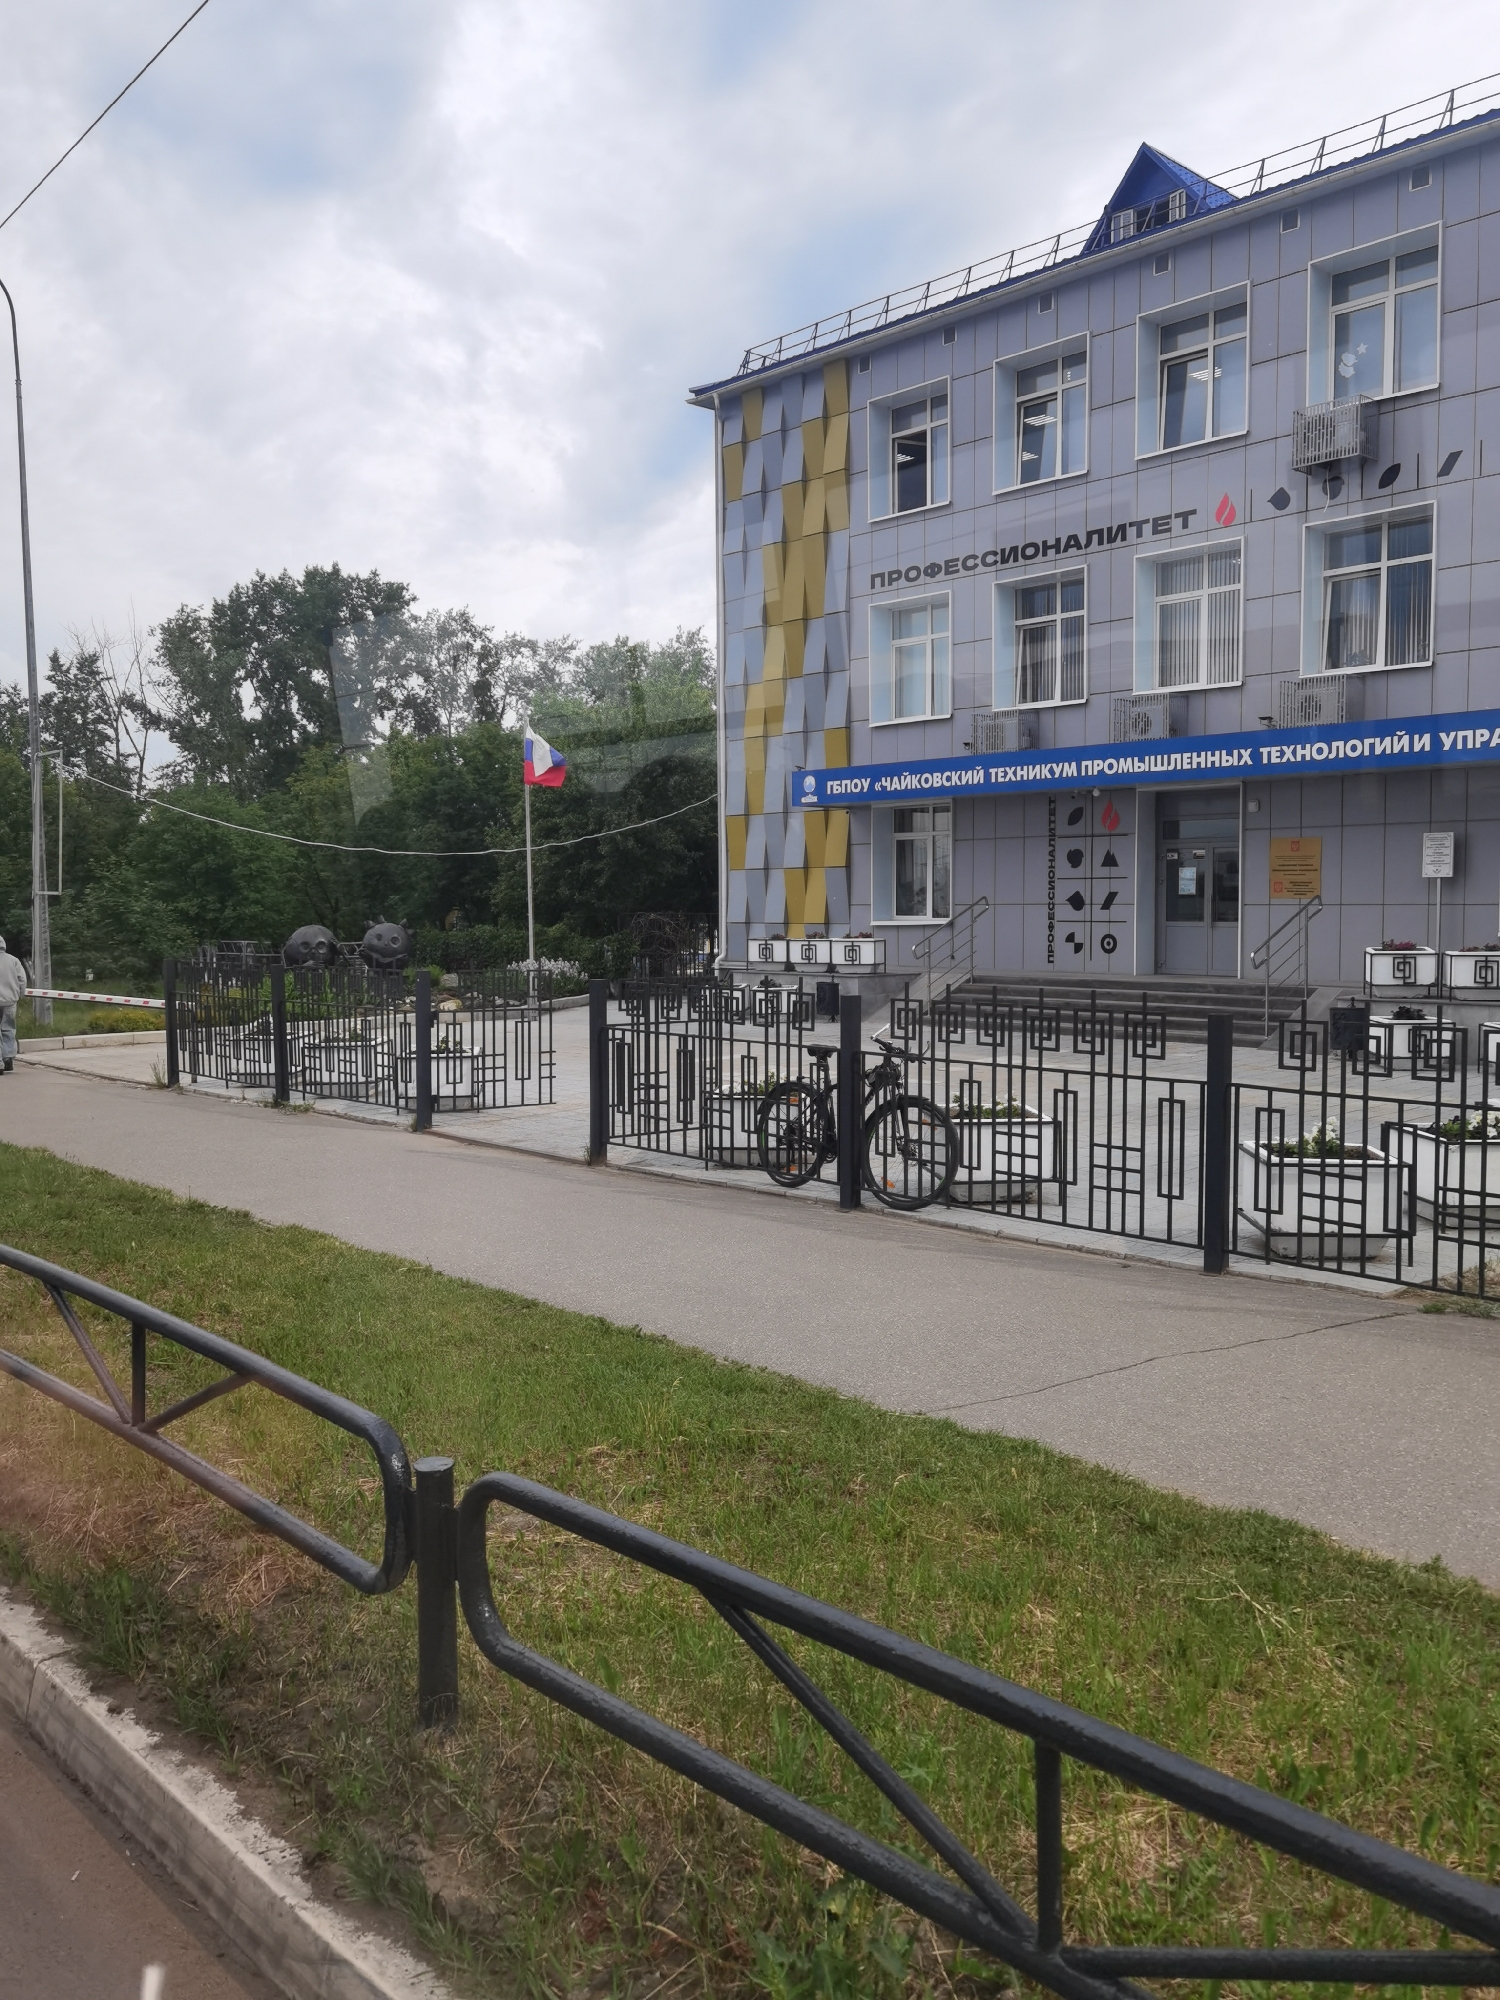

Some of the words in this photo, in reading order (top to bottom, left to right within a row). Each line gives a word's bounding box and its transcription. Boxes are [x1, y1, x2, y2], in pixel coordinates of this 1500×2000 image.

[870, 508, 1197, 589] ПРОФЕССИОНАЛИТЕТ
[826, 777, 871, 795] ГБПОУ
[874, 766, 984, 792] «ЧАЙКОВСКИЙ
[989, 761, 1078, 783] ТЕХНИКУМ
[1081, 748, 1253, 776] ПРОМЫШЛЕННЫХ
[1260, 730, 1410, 764] ТЕХНОЛОГИЙ
[1414, 733, 1431, 752] И
[1047, 796, 1056, 964] ПРОФЕССИОНАЛИТЕТ
